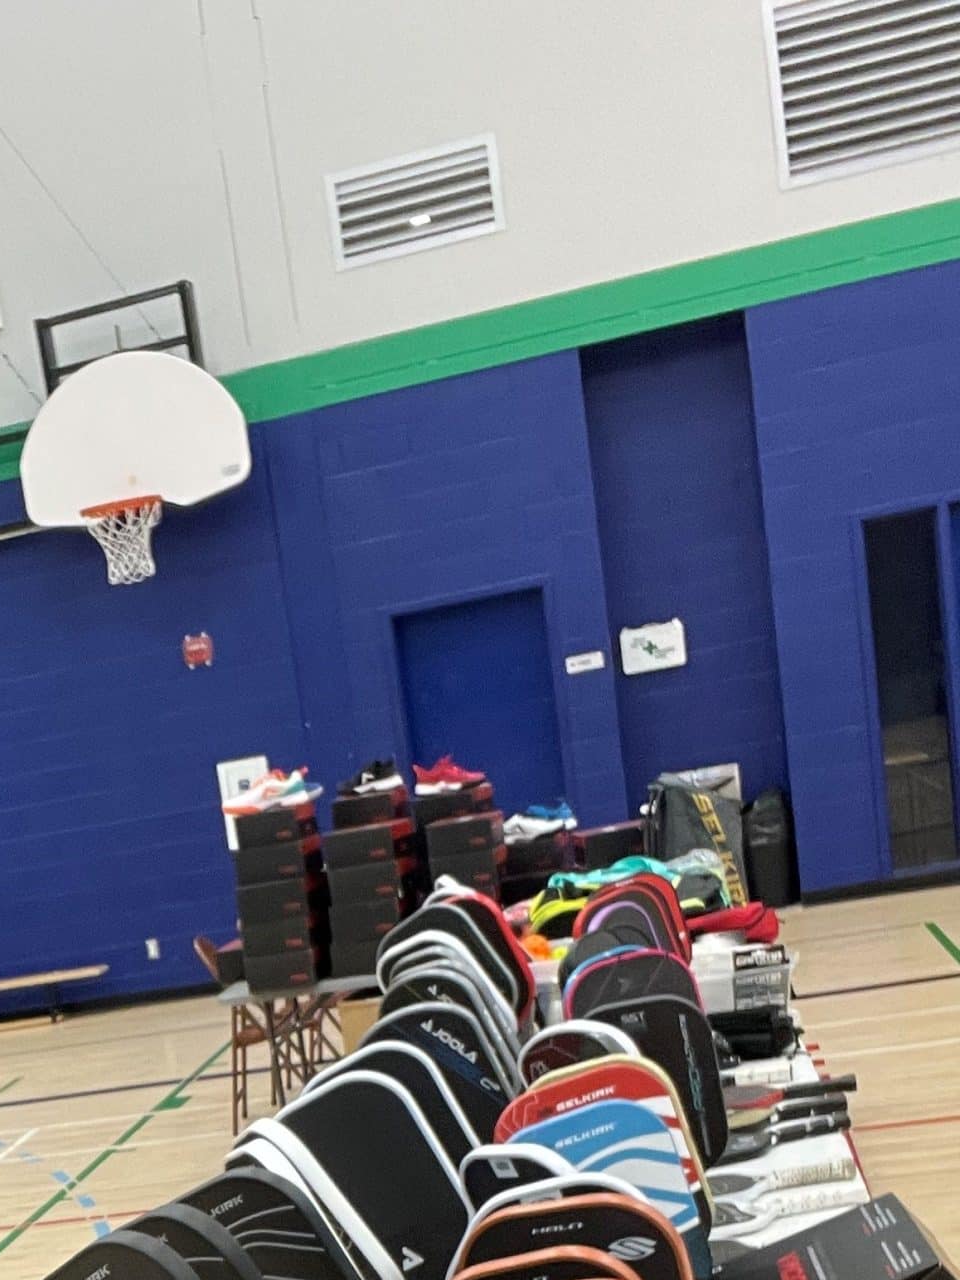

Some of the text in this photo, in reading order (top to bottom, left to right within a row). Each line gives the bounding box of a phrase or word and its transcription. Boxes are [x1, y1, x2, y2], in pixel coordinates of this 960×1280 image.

[692, 793, 747, 908] SELKIR
[432, 1028, 478, 1065] JOOLA
[556, 1084, 617, 1112] SELKIRK
[554, 1121, 618, 1149] SELKIRK
[210, 1194, 244, 1217] KIRK
[531, 1221, 584, 1236] HALO
